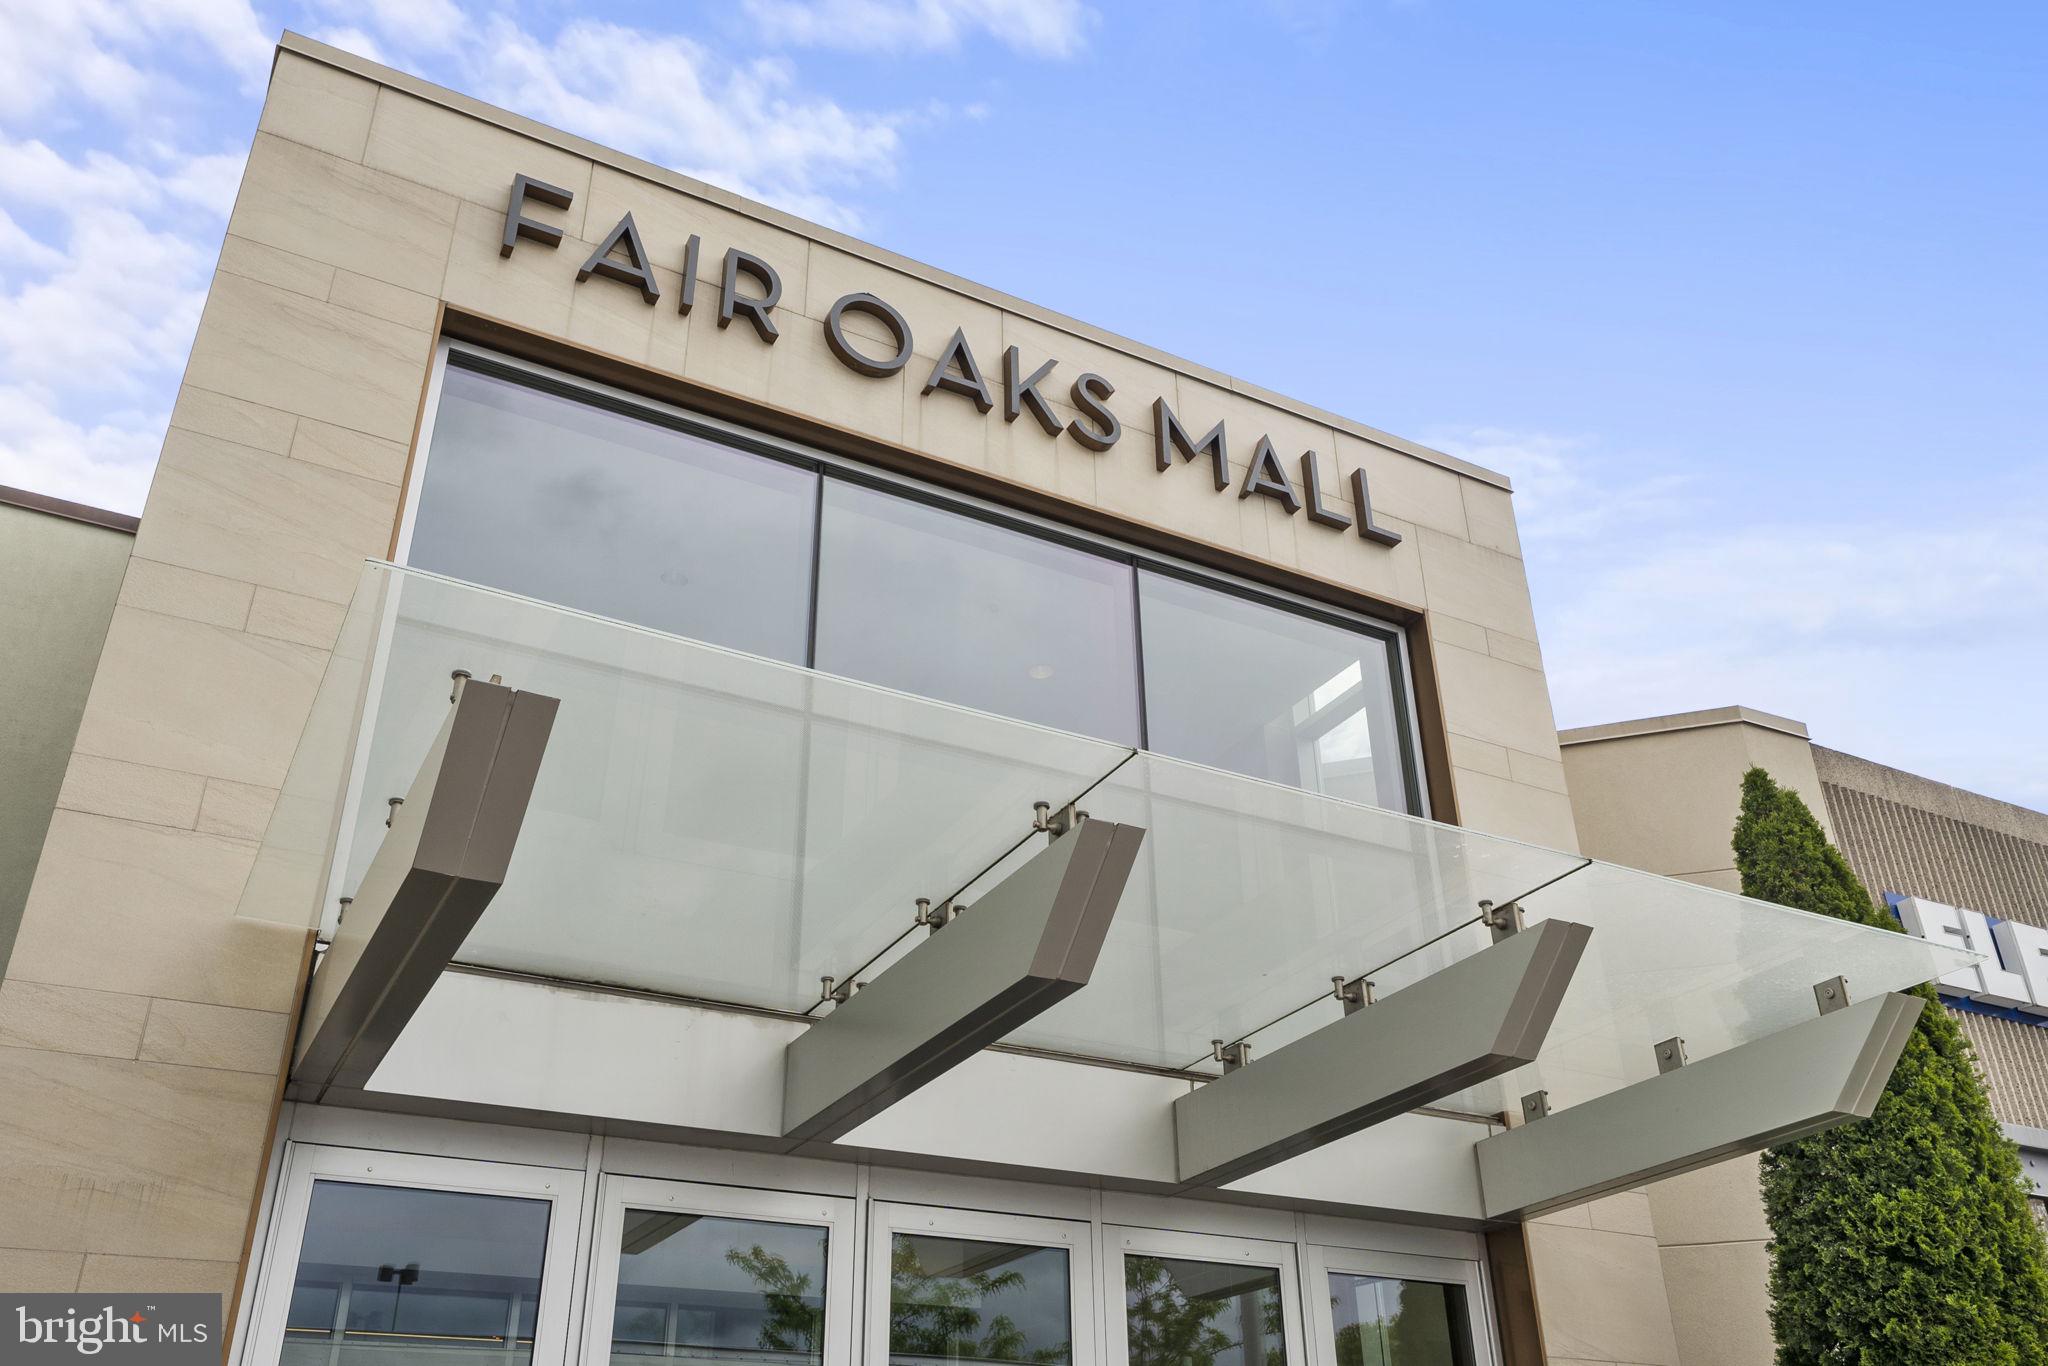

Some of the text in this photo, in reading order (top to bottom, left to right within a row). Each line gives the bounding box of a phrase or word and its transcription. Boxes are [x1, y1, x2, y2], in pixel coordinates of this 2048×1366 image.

[500, 173, 1403, 549] FAIR OAKS MALL
